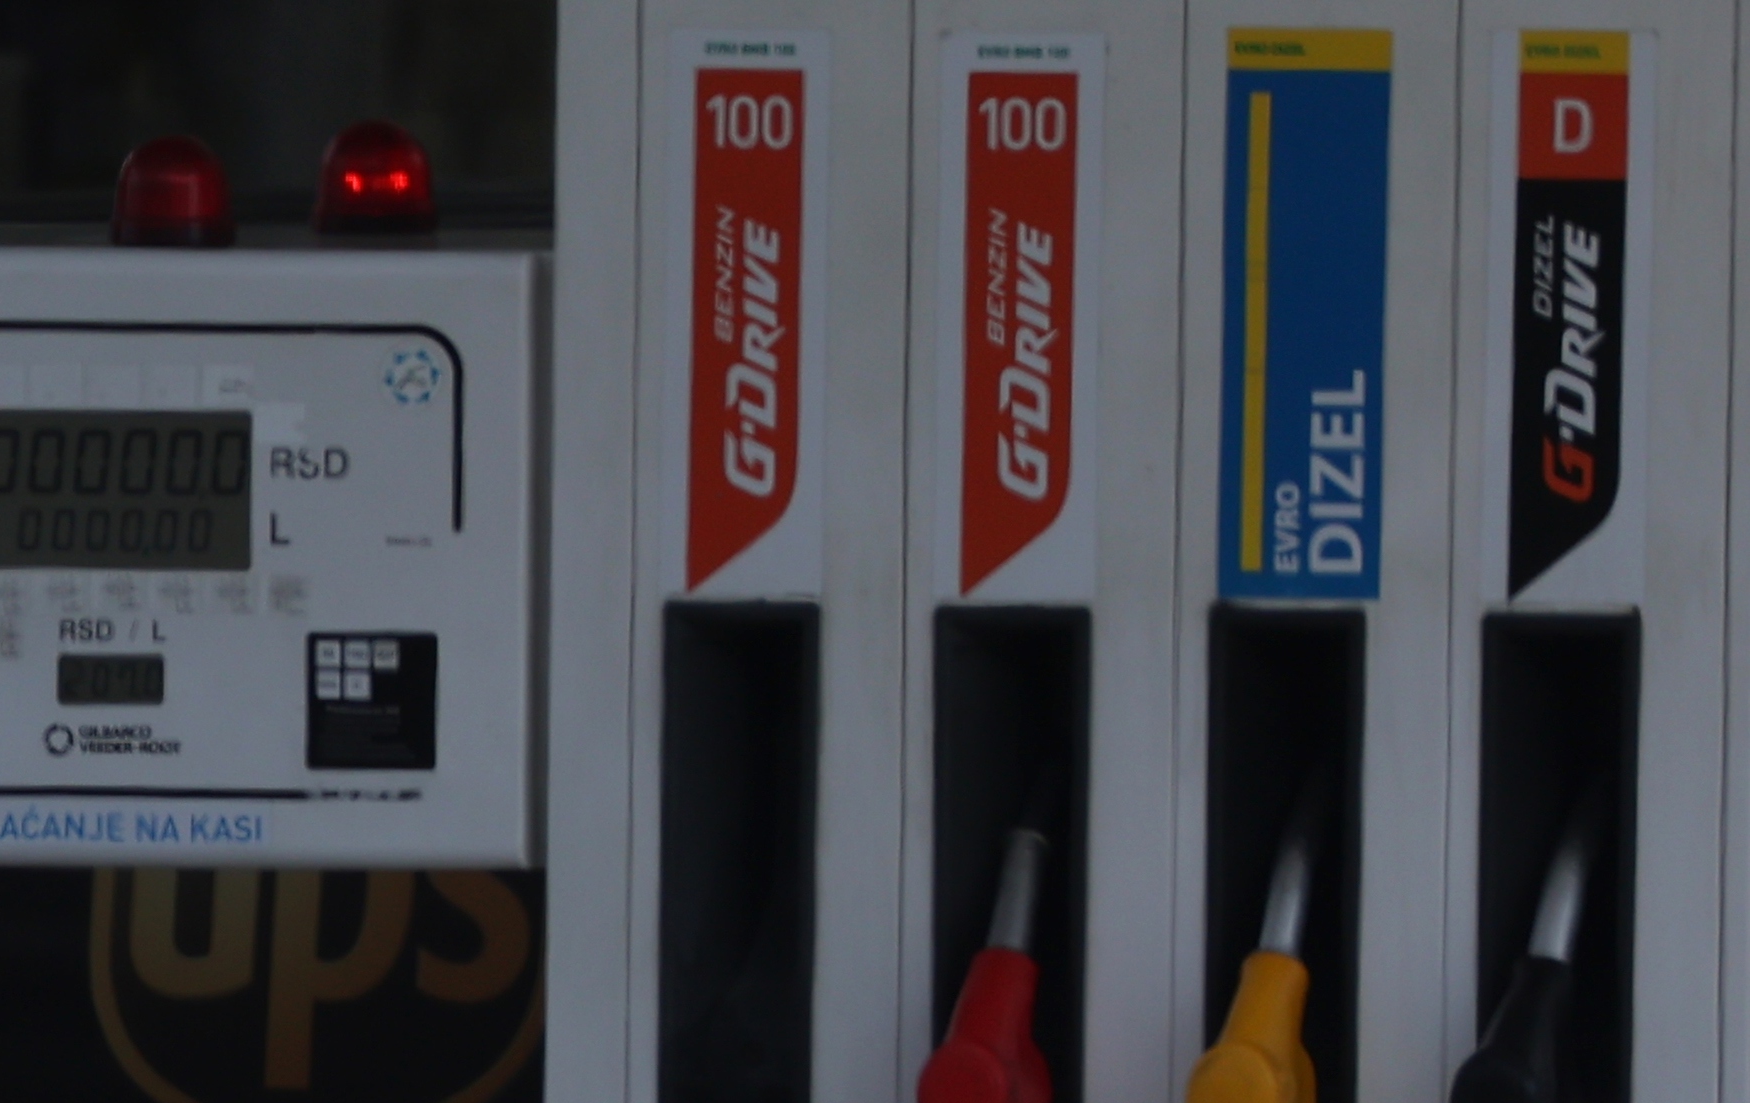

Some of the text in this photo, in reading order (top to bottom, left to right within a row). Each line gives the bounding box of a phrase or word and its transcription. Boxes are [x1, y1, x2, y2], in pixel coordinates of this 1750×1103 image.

[705, 94, 794, 151] 100
[978, 96, 1067, 152] 100
[1552, 96, 1594, 154] D
[713, 203, 736, 345] BENZIN
[985, 206, 1009, 347] BENZIN
[1532, 215, 1556, 319] DIZEL
[269, 446, 349, 482] RSD
[1307, 368, 1366, 575] DIZEL
[270, 512, 290, 547] L
[1273, 480, 1302, 574] EVRO
[58, 617, 166, 643] RSD / L
[136, 813, 180, 843] NA
[191, 813, 262, 843] KASI
